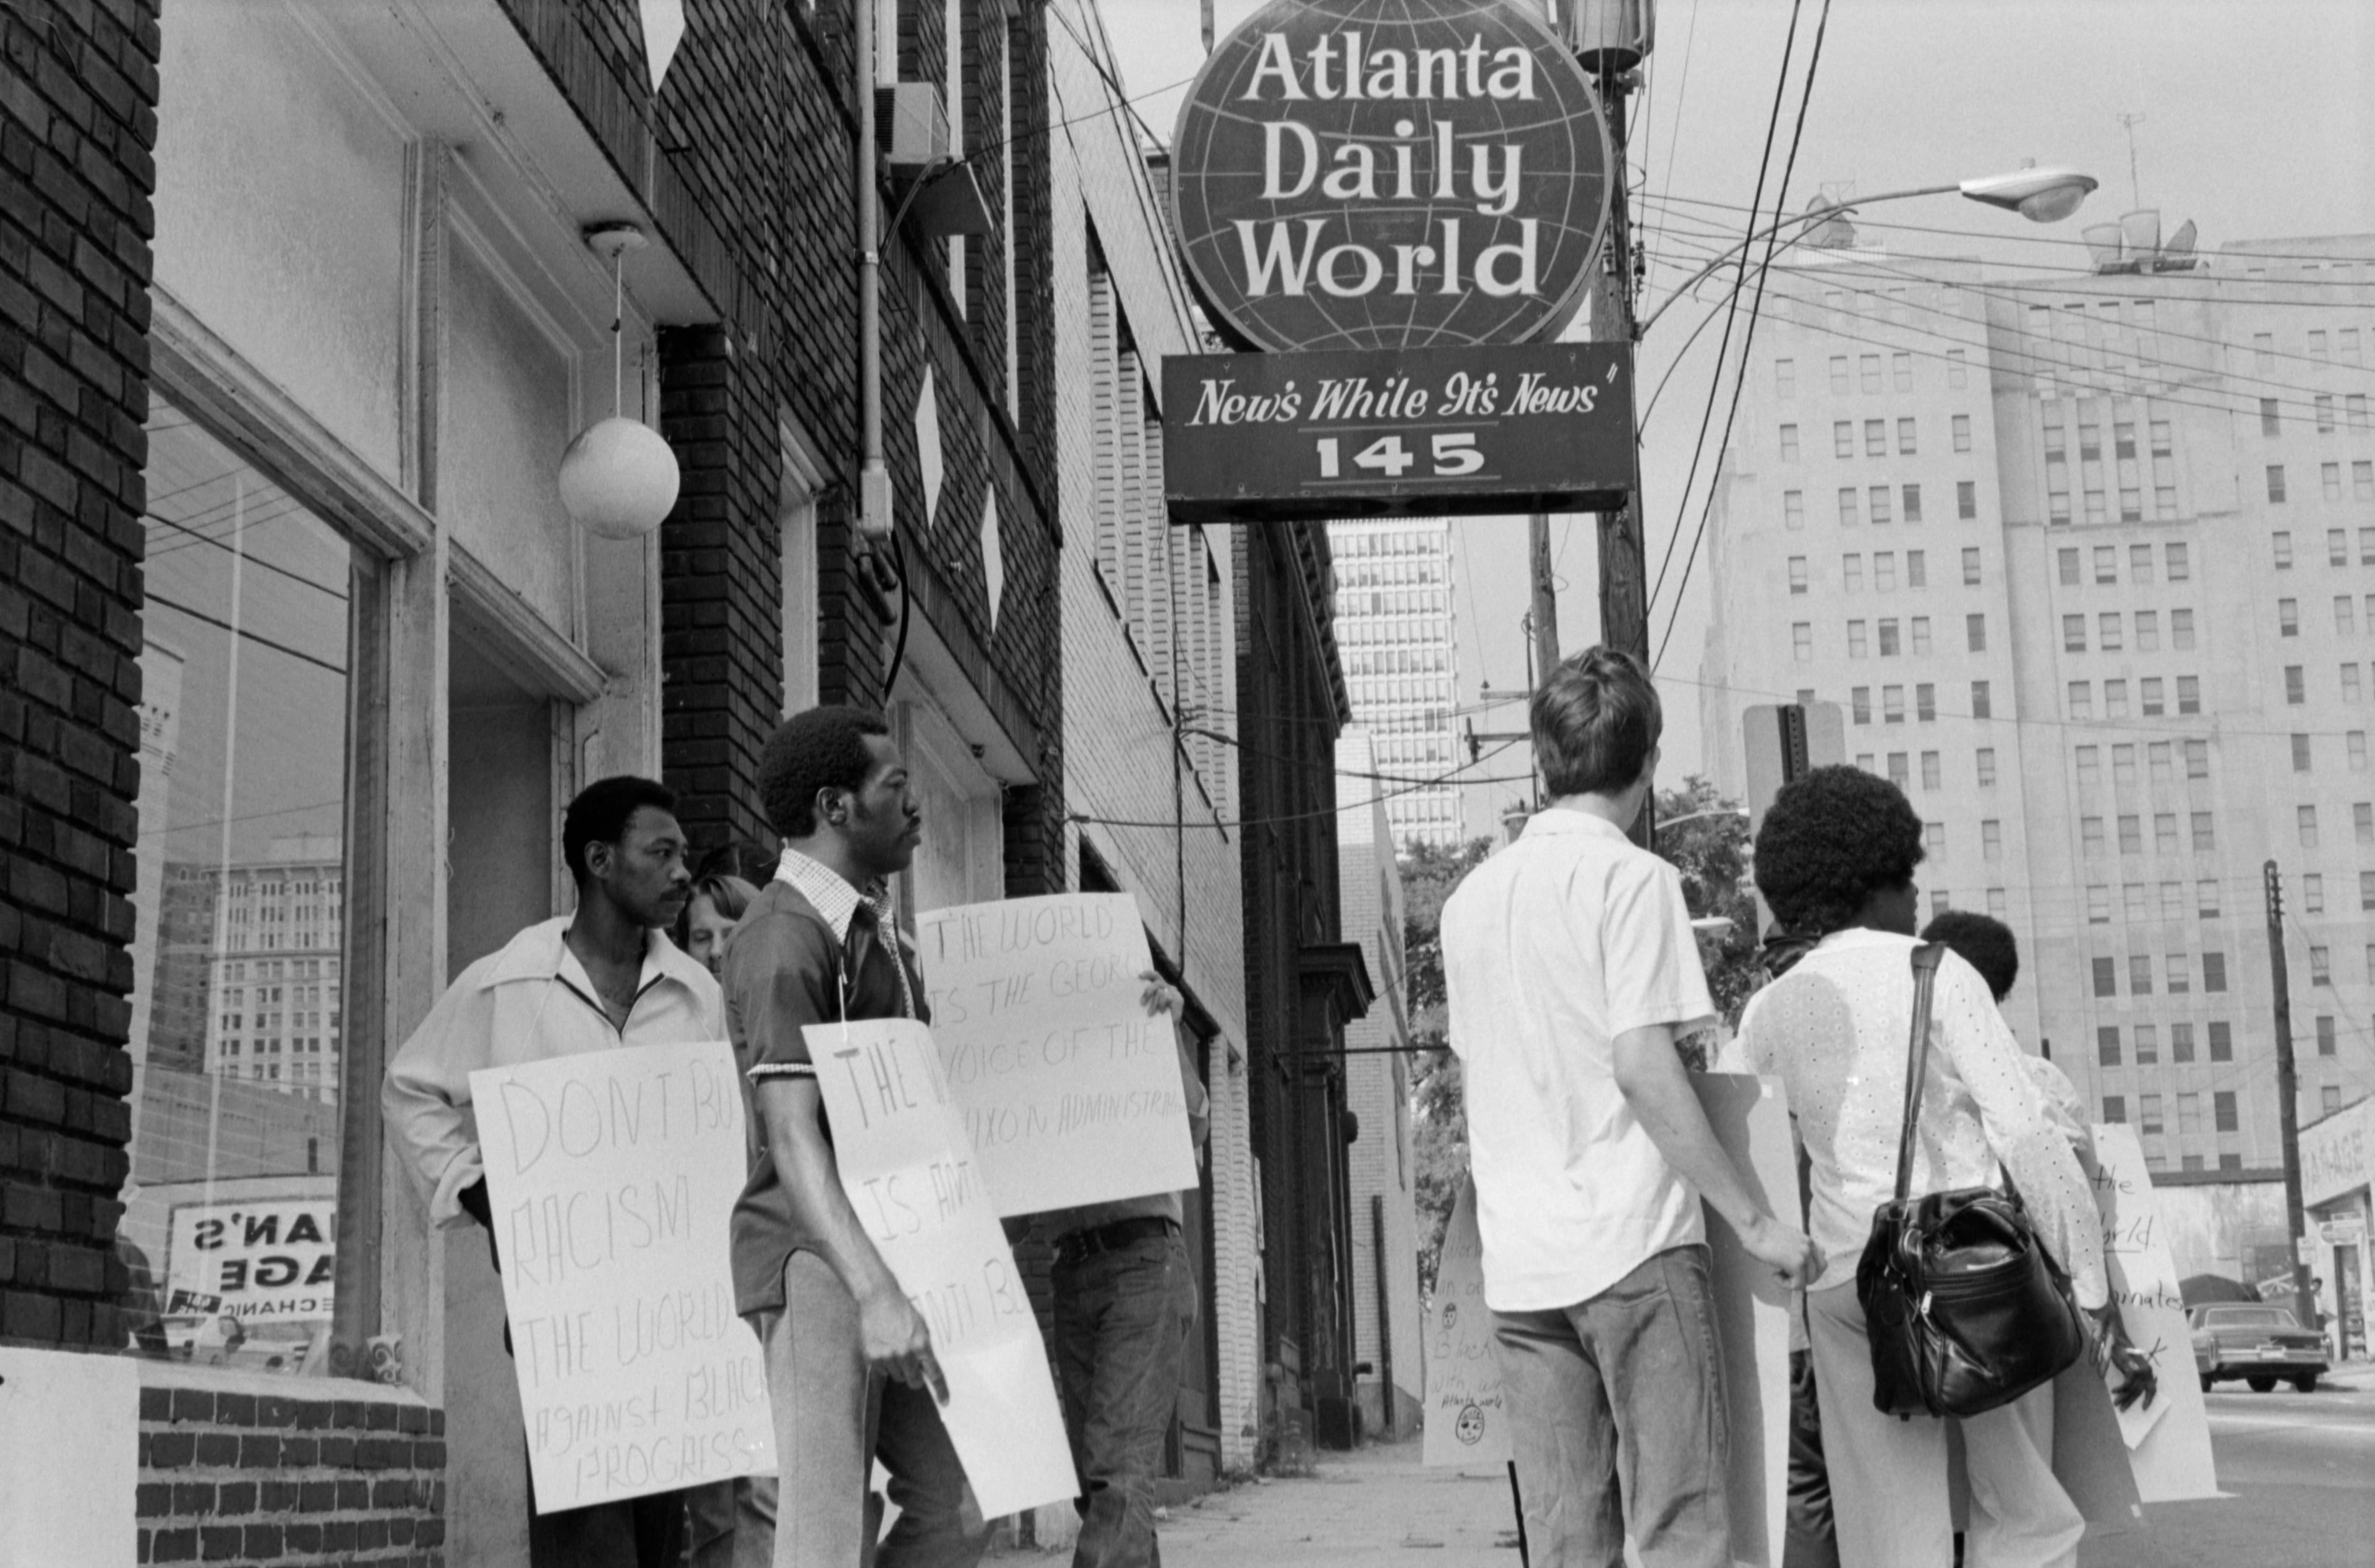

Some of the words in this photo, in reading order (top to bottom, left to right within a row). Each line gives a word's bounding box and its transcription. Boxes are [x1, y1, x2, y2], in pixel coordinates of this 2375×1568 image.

[1239, 31, 1542, 101] Atlanta
[1257, 119, 1524, 215] Daily
[1230, 218, 1544, 296] World
[1309, 377, 1428, 421] While
[1439, 371, 1499, 416] It's
[1317, 432, 1484, 478] 145
[925, 913, 990, 964] THE
[999, 904, 1113, 953] WORLD
[930, 987, 968, 1029] IS
[978, 972, 1035, 1016] THE
[1043, 1027, 1090, 1066] OF
[1103, 1022, 1159, 1060] THE
[832, 1039, 918, 1130] THE
[863, 1174, 922, 1242] IS
[2092, 1163, 2137, 1195] the
[511, 1175, 691, 1291] RACISM
[518, 1311, 594, 1388] THE
[616, 1283, 730, 1366] WORLD
[575, 1426, 756, 1500] PROGRESS
